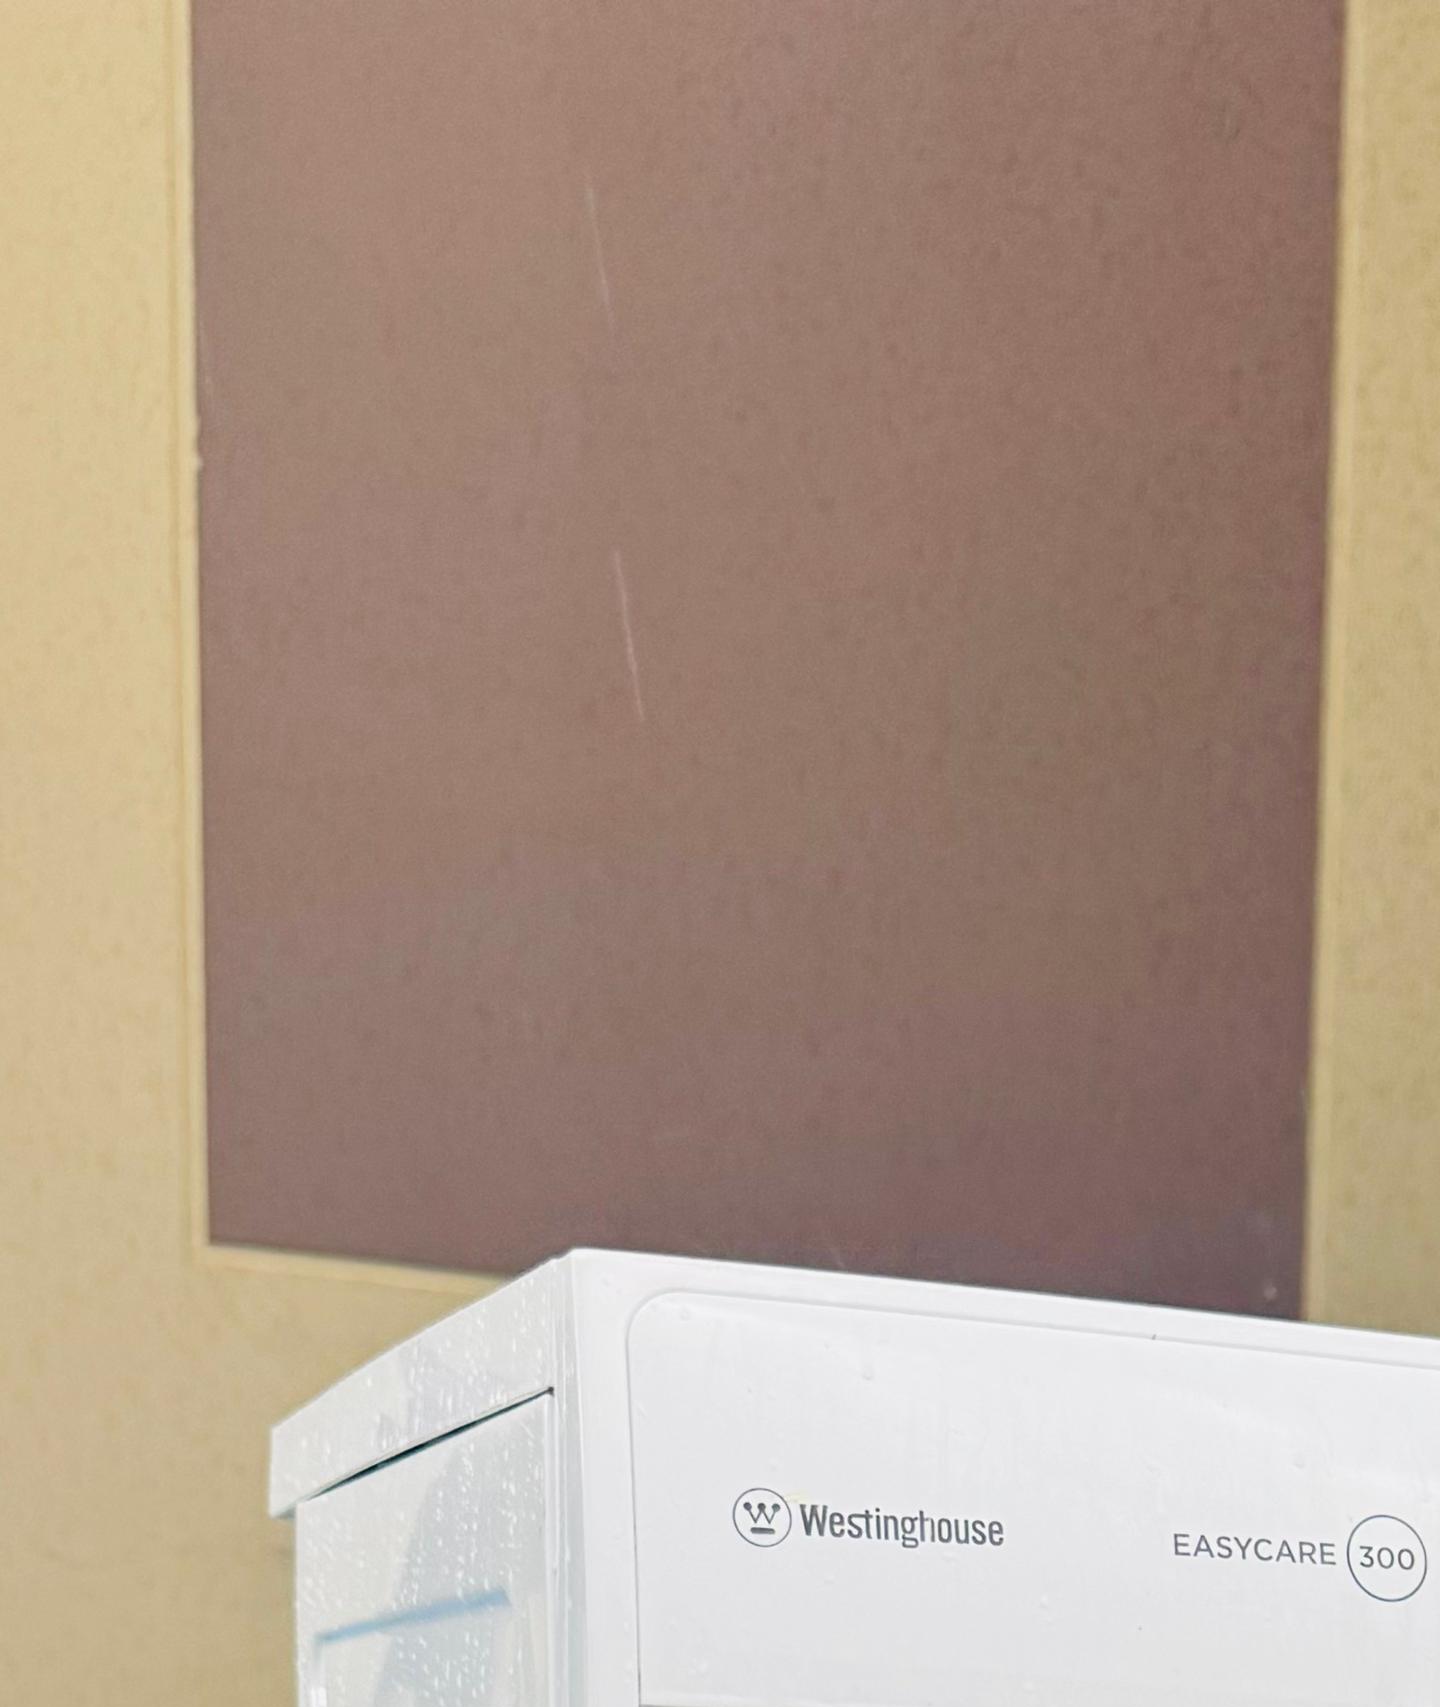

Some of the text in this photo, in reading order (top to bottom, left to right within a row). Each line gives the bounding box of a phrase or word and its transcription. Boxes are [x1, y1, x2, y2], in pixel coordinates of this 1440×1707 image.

[799, 1503, 1005, 1549] Westinghouse
[1173, 1533, 1416, 1570] EASYCARE 300
